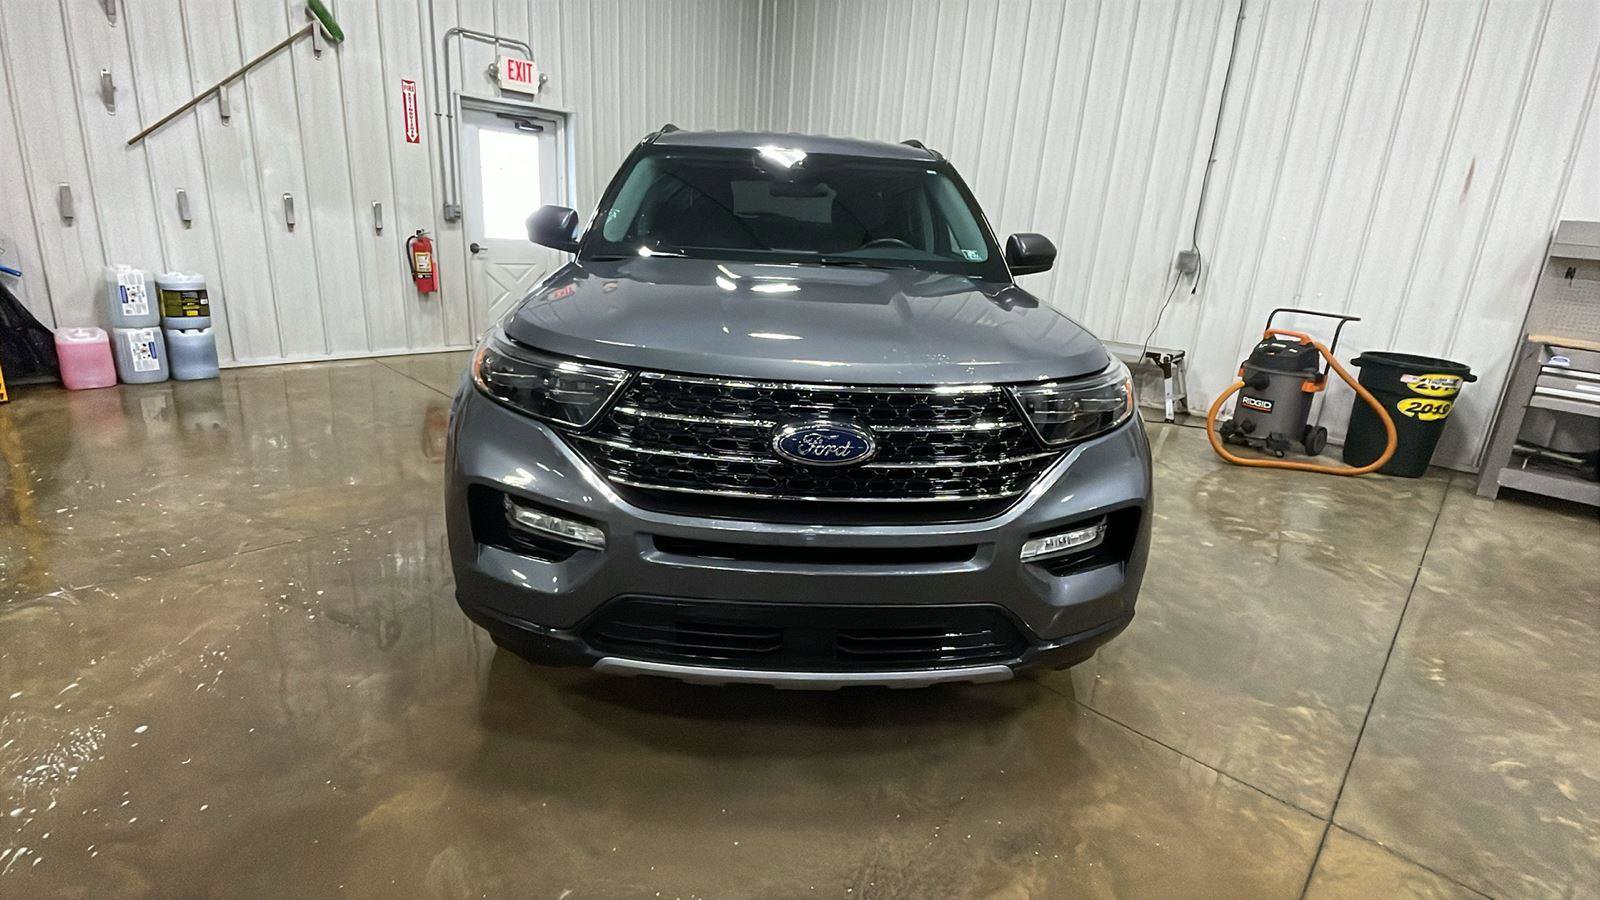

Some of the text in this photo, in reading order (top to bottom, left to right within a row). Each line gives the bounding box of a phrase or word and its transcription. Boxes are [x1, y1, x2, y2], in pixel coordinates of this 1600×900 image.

[507, 58, 533, 84] EXIT
[1242, 396, 1272, 409] RIDGID
[797, 432, 854, 456] Ford
